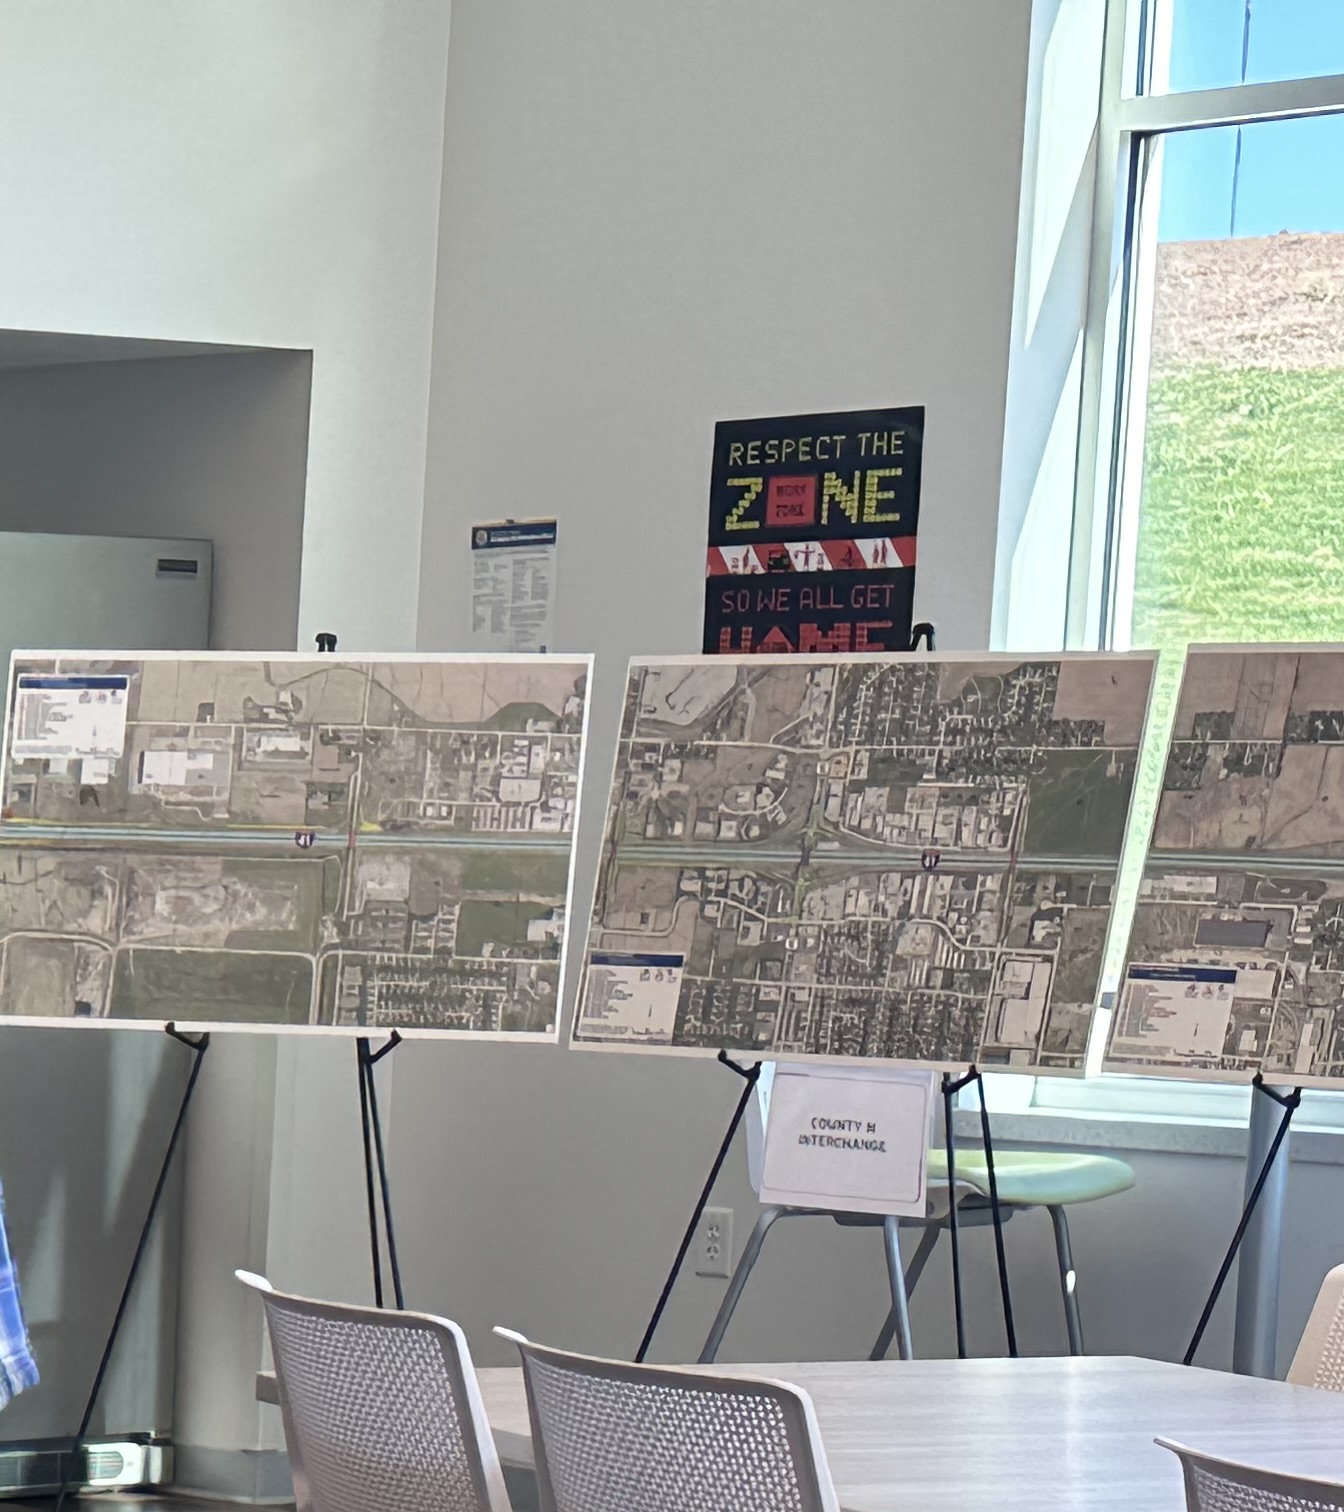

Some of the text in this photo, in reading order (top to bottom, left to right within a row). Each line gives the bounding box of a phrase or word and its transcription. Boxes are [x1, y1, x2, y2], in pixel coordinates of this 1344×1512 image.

[728, 431, 906, 467] RESPECT THE
[721, 584, 896, 614] SO WE ALL GET
[811, 1117, 862, 1132] COUNTY
[798, 1133, 887, 1153] INTERCHANGE
